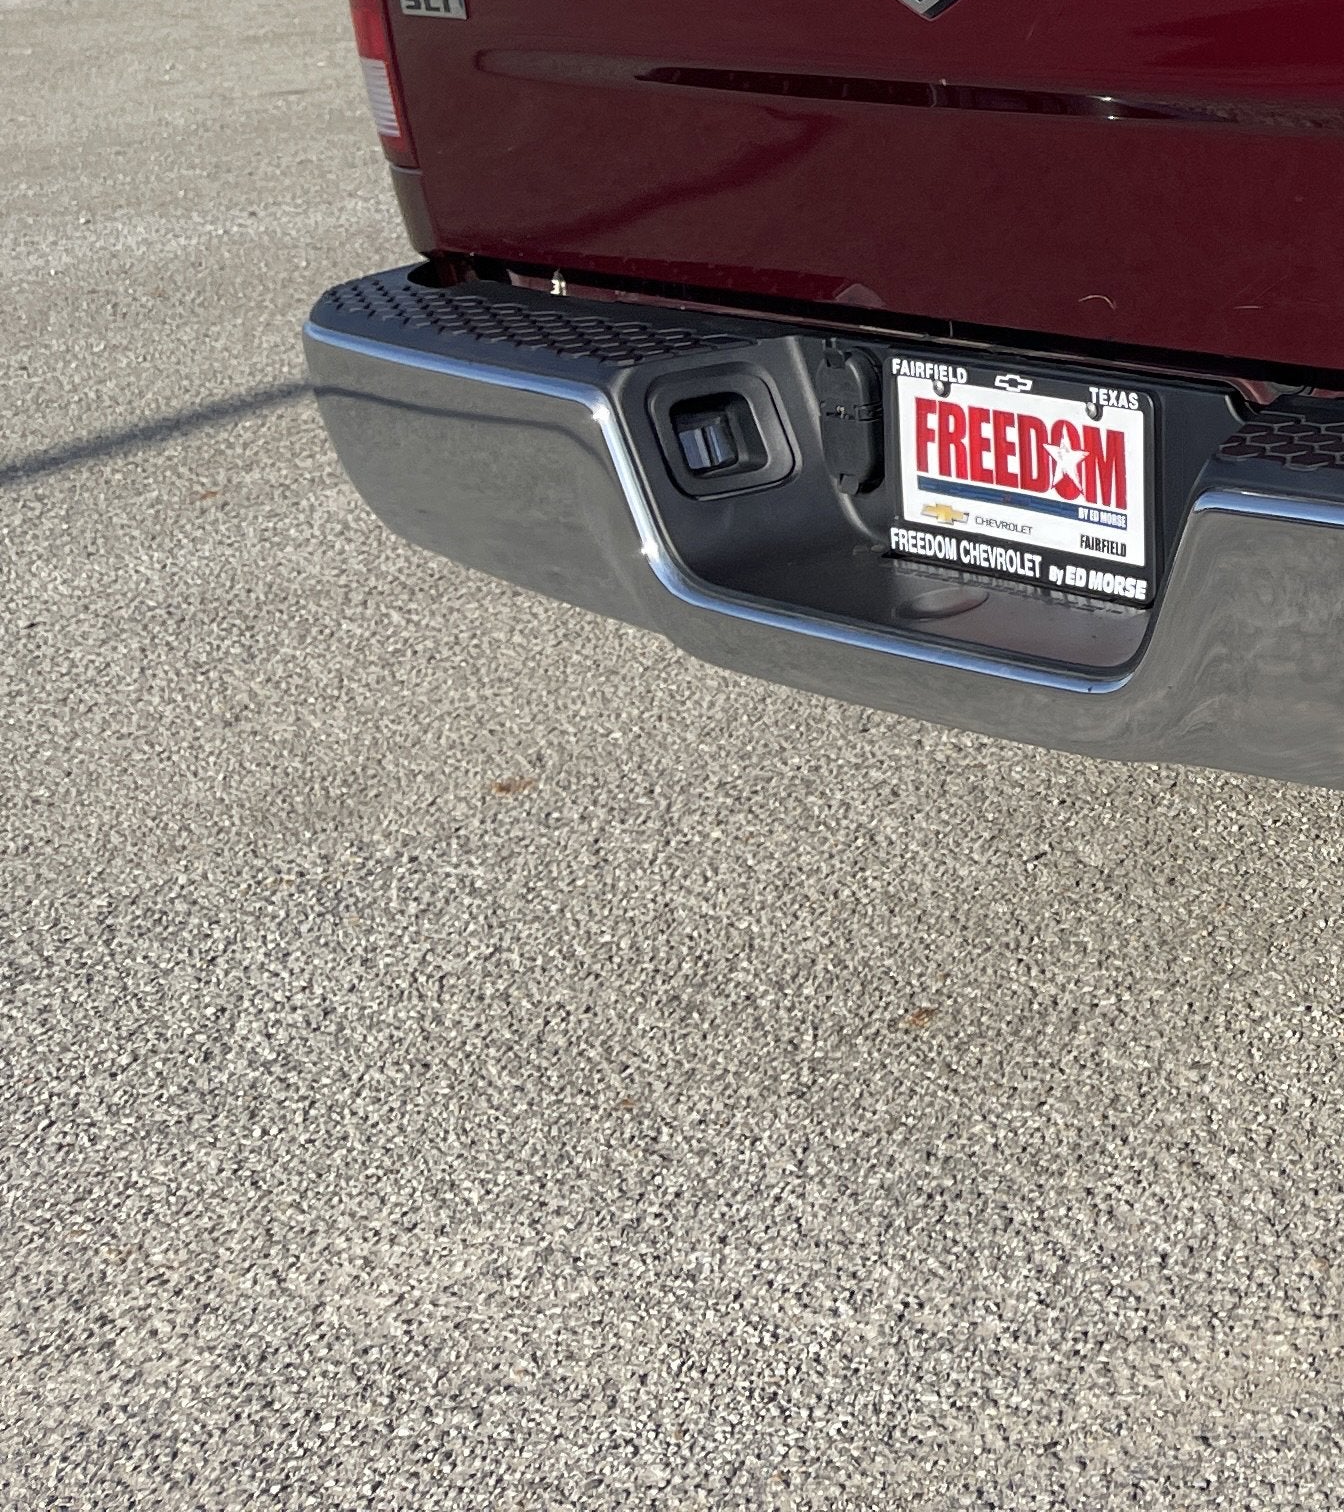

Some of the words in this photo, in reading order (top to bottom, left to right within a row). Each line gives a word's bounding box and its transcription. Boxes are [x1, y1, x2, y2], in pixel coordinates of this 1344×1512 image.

[892, 358, 968, 384] FAIRFIELD
[1089, 386, 1139, 410] TEXAS
[914, 397, 1127, 510] FREEDOM
[975, 516, 1033, 535] CHEVROLET
[1080, 534, 1127, 557] FAIRFIELD
[890, 527, 957, 561] FREEDOM
[960, 539, 1043, 578] CHEVROLET
[1065, 565, 1086, 587] ED
[1088, 570, 1147, 600] MORSE
